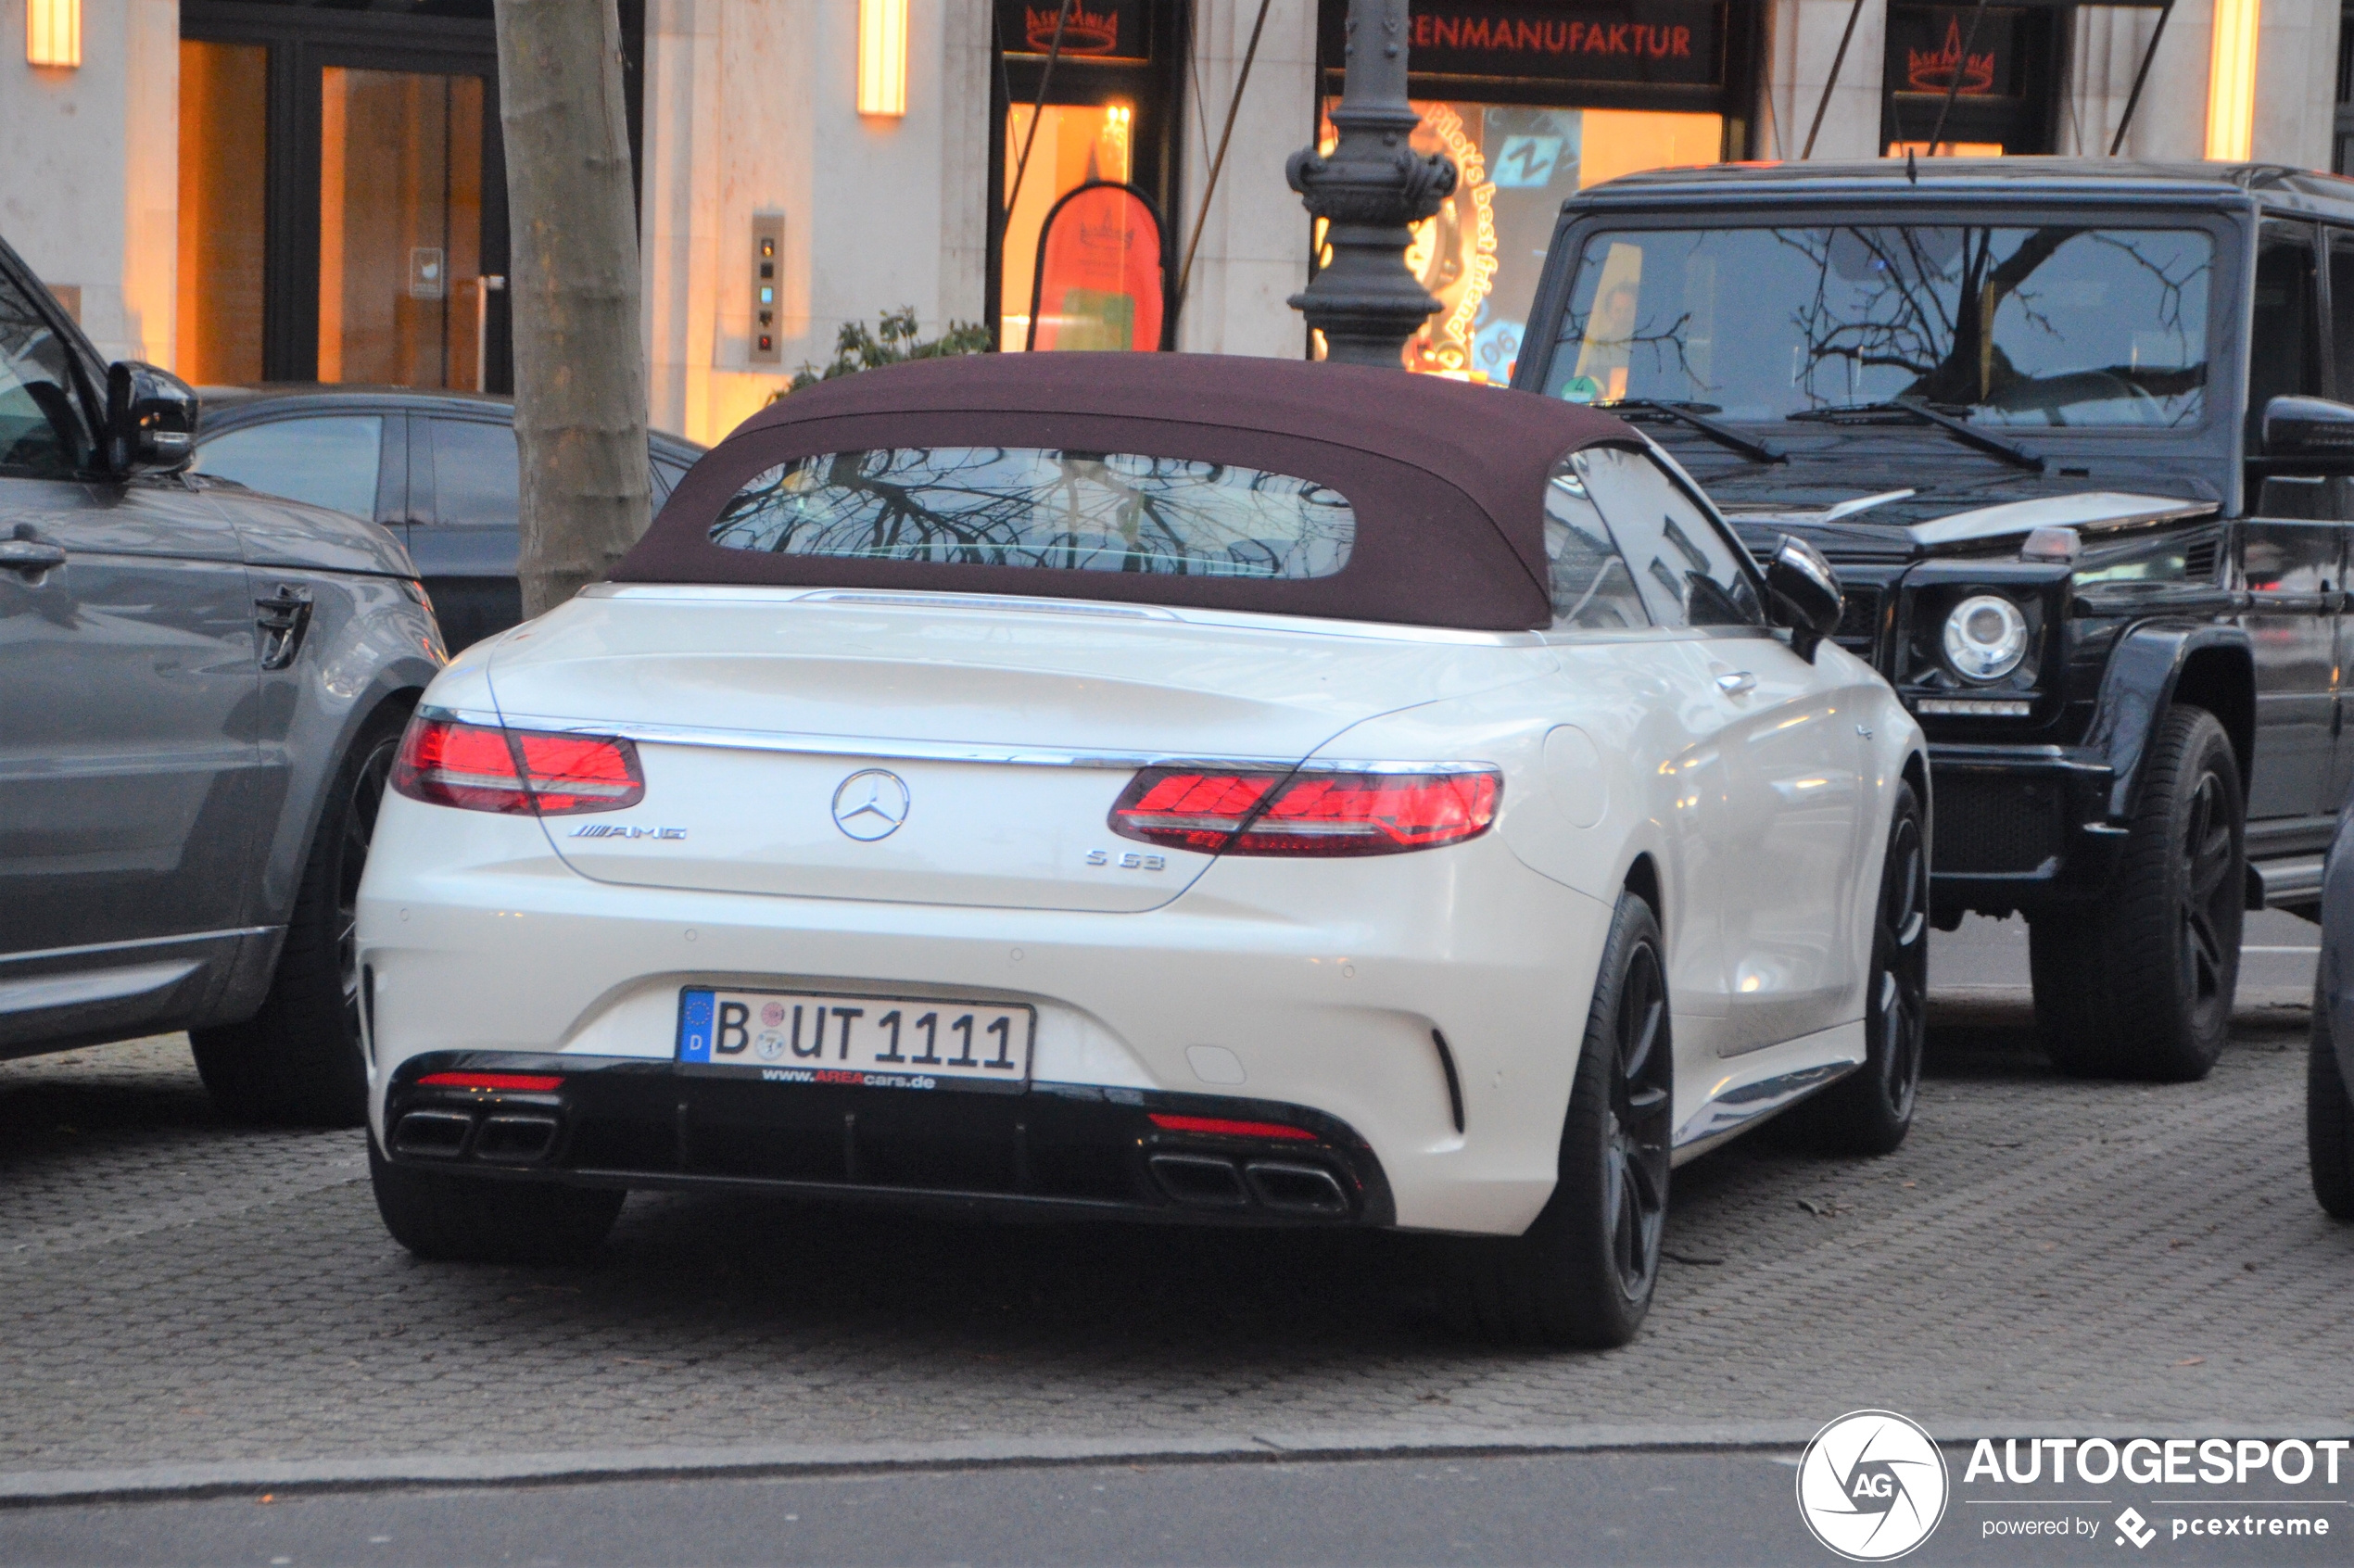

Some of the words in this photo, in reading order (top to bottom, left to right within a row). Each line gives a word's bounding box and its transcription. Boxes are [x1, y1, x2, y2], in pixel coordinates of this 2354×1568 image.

[1472, 182, 1498, 253] best
[1445, 253, 1500, 346] friend
[1086, 849, 1108, 866] S
[1119, 852, 1166, 871] 63
[690, 1033, 702, 1051] D
[715, 1001, 750, 1055] B
[791, 1004, 864, 1060] UT
[875, 1009, 1016, 1070] 1111
[762, 1069, 937, 1090] www.AREAcars.de
